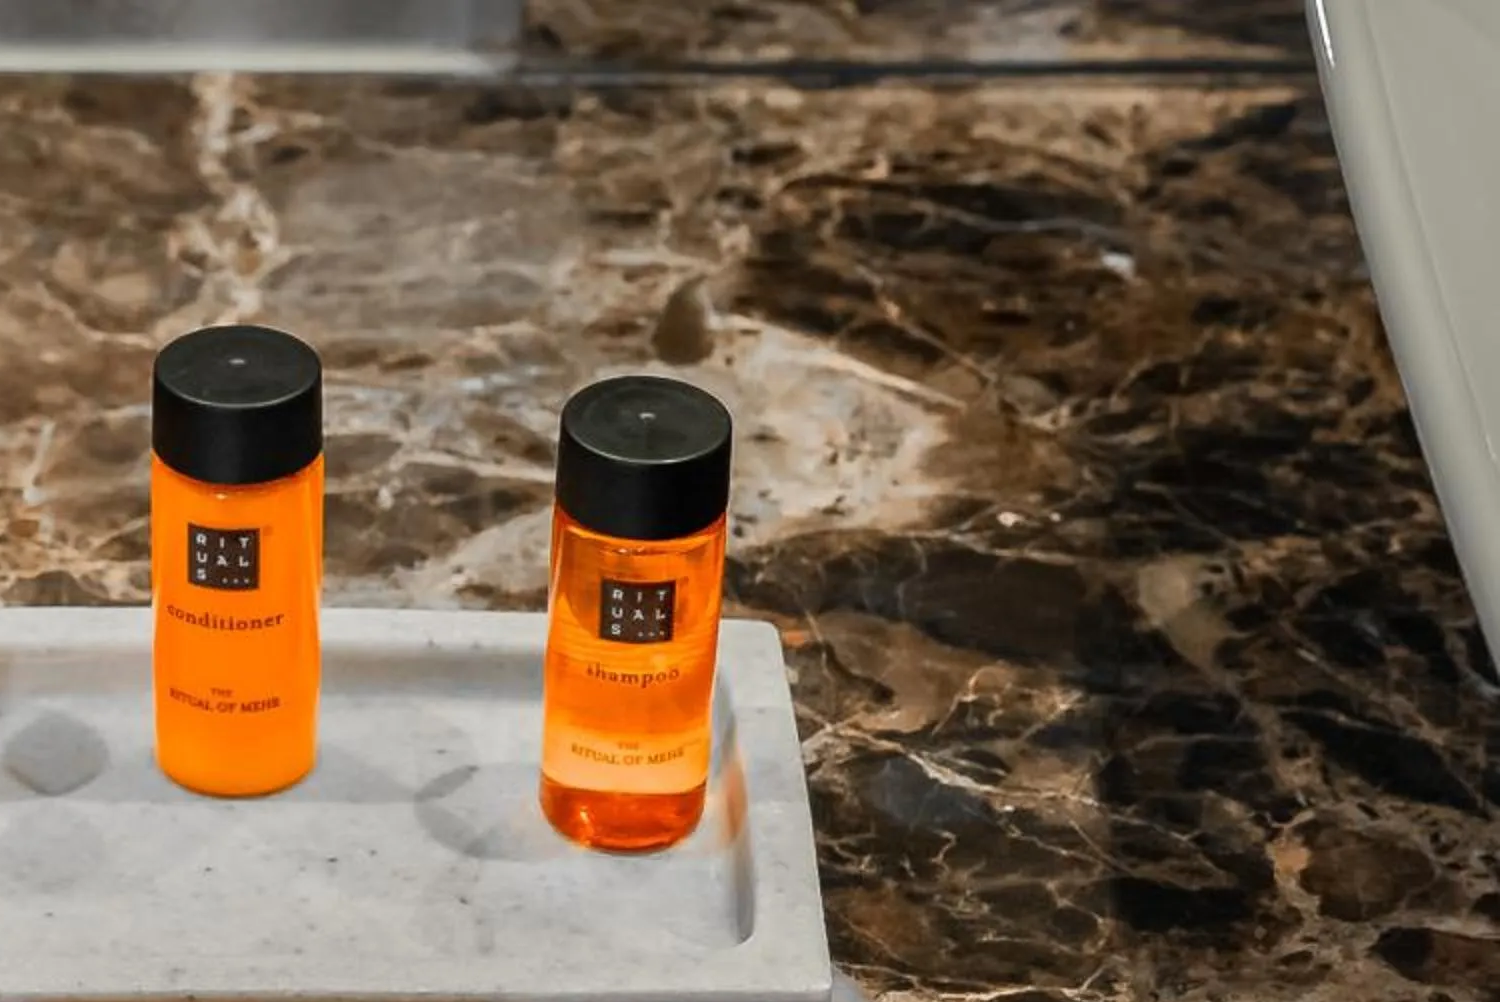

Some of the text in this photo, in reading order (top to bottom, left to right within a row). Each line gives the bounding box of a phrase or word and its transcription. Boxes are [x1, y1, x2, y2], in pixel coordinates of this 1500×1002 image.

[166, 603, 285, 632] conditioner
[586, 662, 681, 689] shampoo
[169, 687, 212, 711] RITUAL
[216, 702, 236, 714] OF
[571, 743, 621, 766] RITUAL
[623, 754, 643, 766] OF
